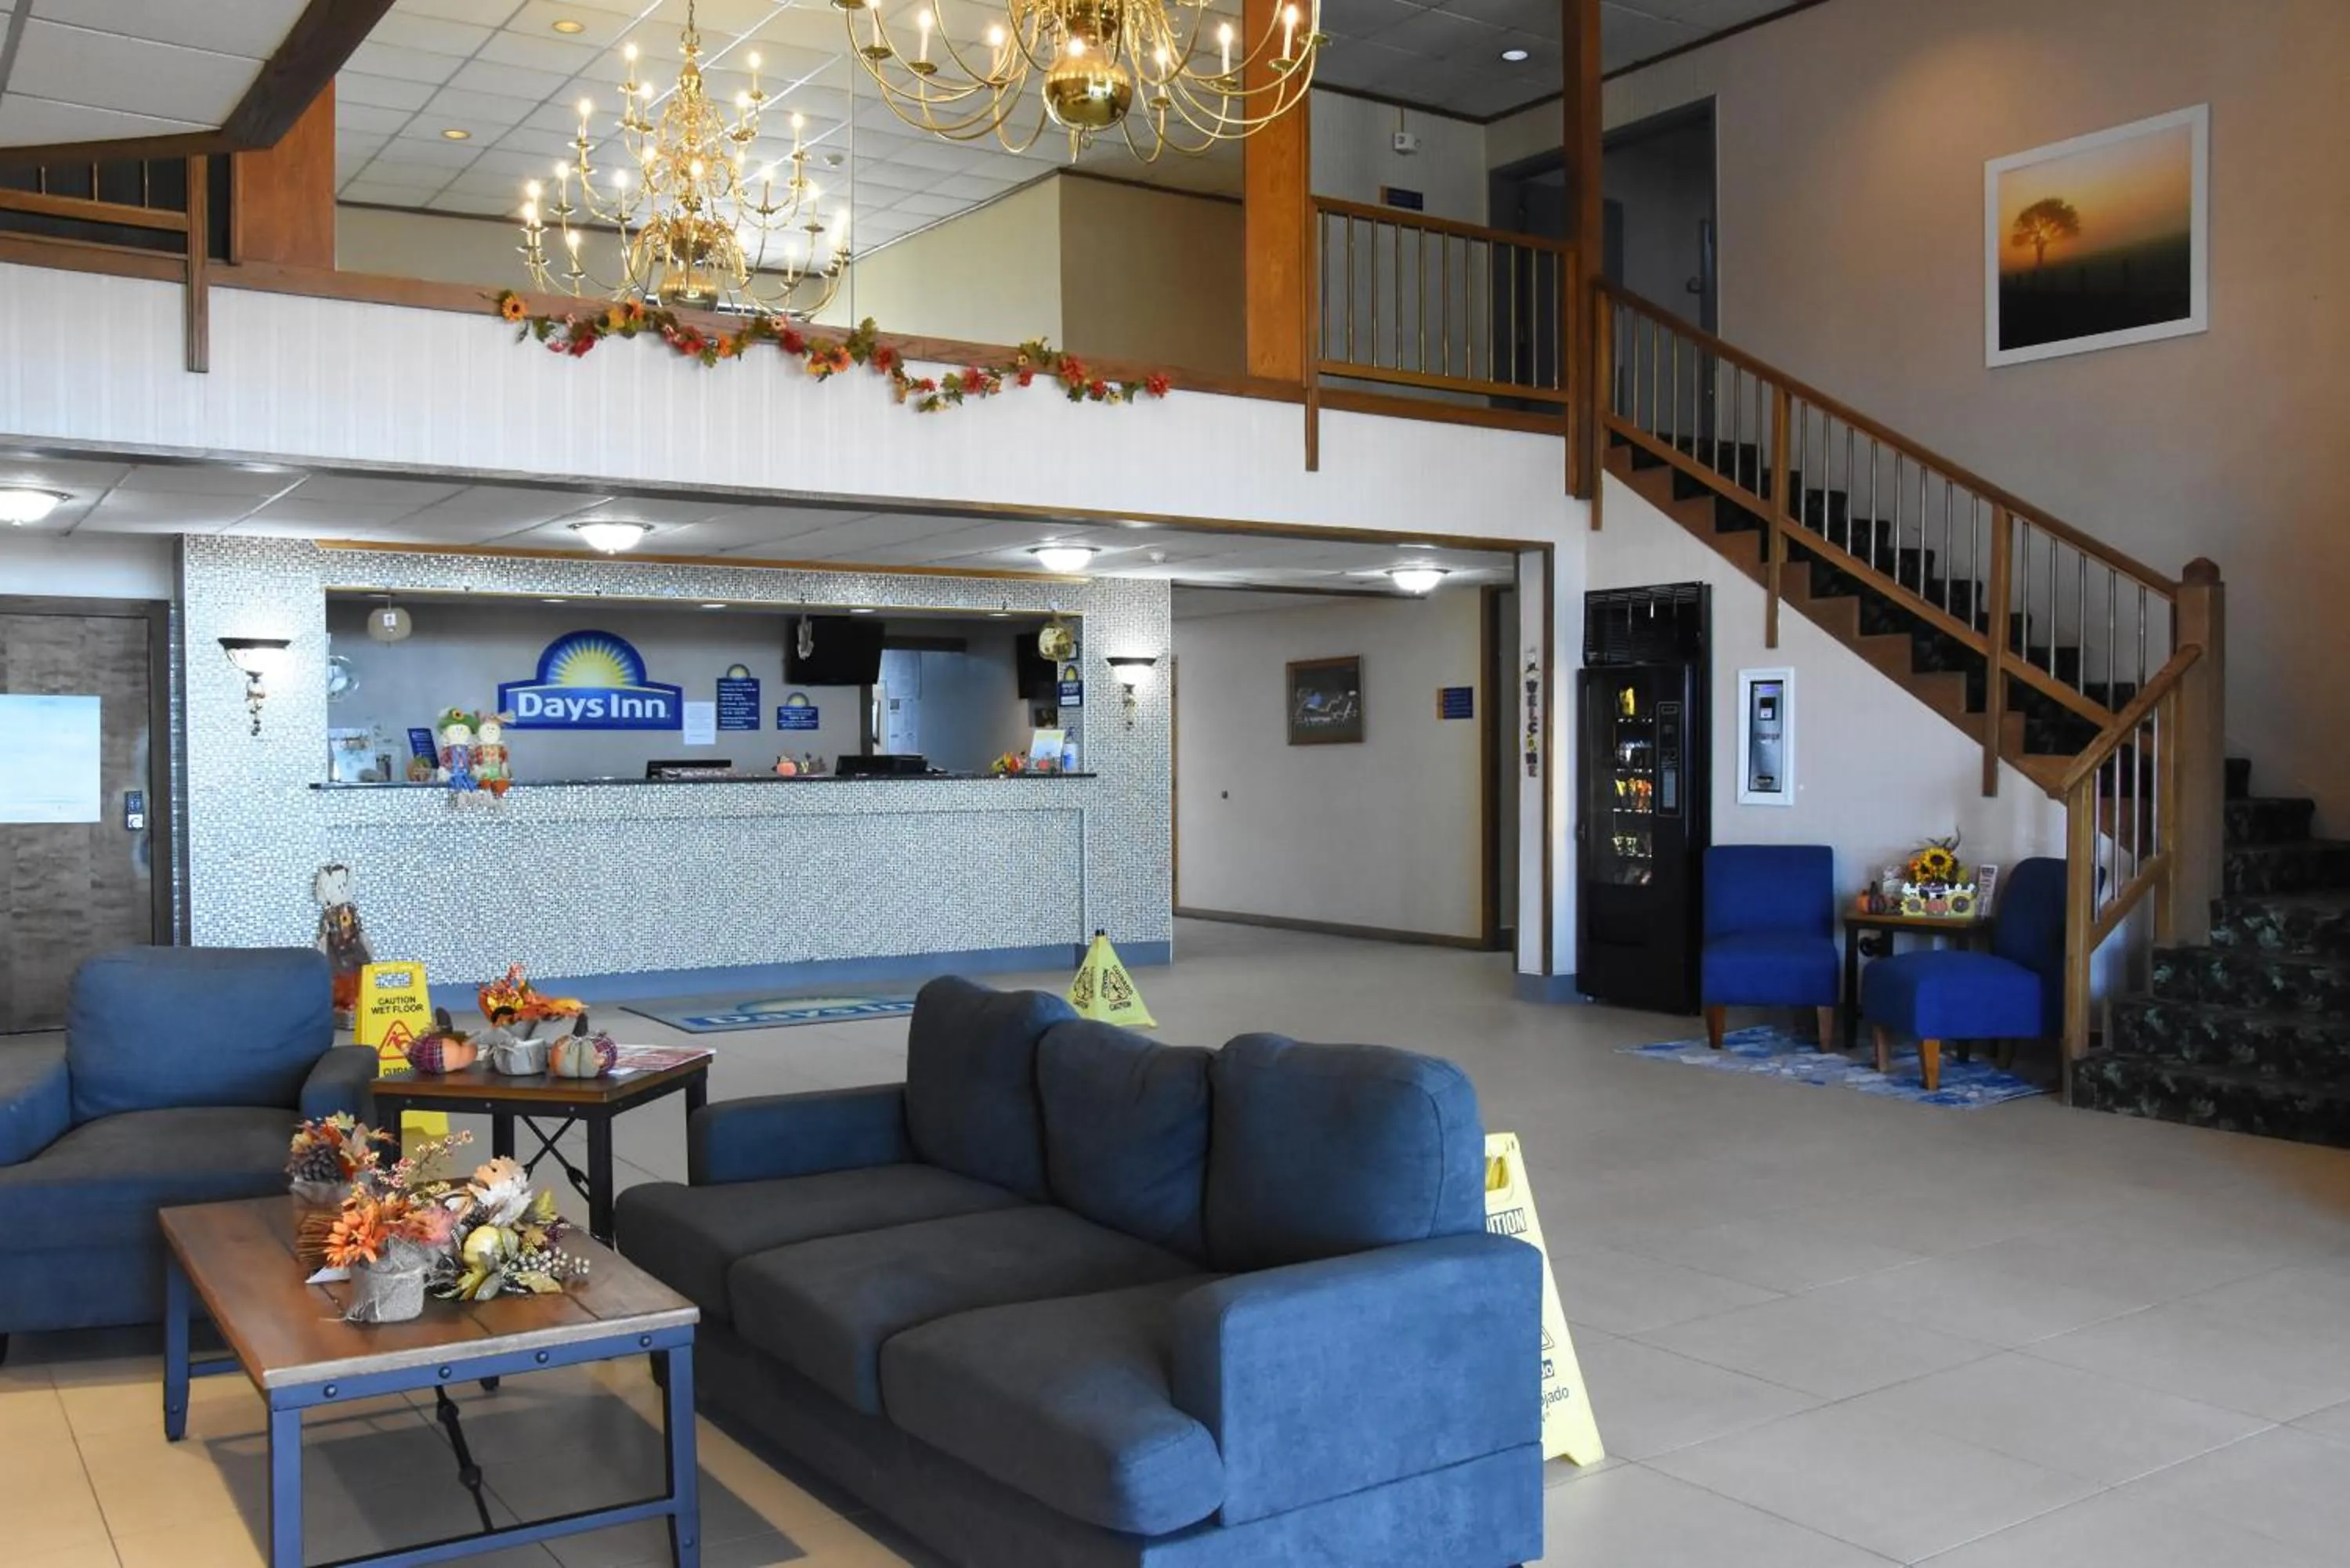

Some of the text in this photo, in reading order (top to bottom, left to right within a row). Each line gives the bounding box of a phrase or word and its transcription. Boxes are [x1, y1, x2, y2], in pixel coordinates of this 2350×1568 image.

[518, 692, 666, 721] Days Inn
[378, 996, 416, 1005] CAUTION
[371, 1003, 424, 1014] WET FLOOR
